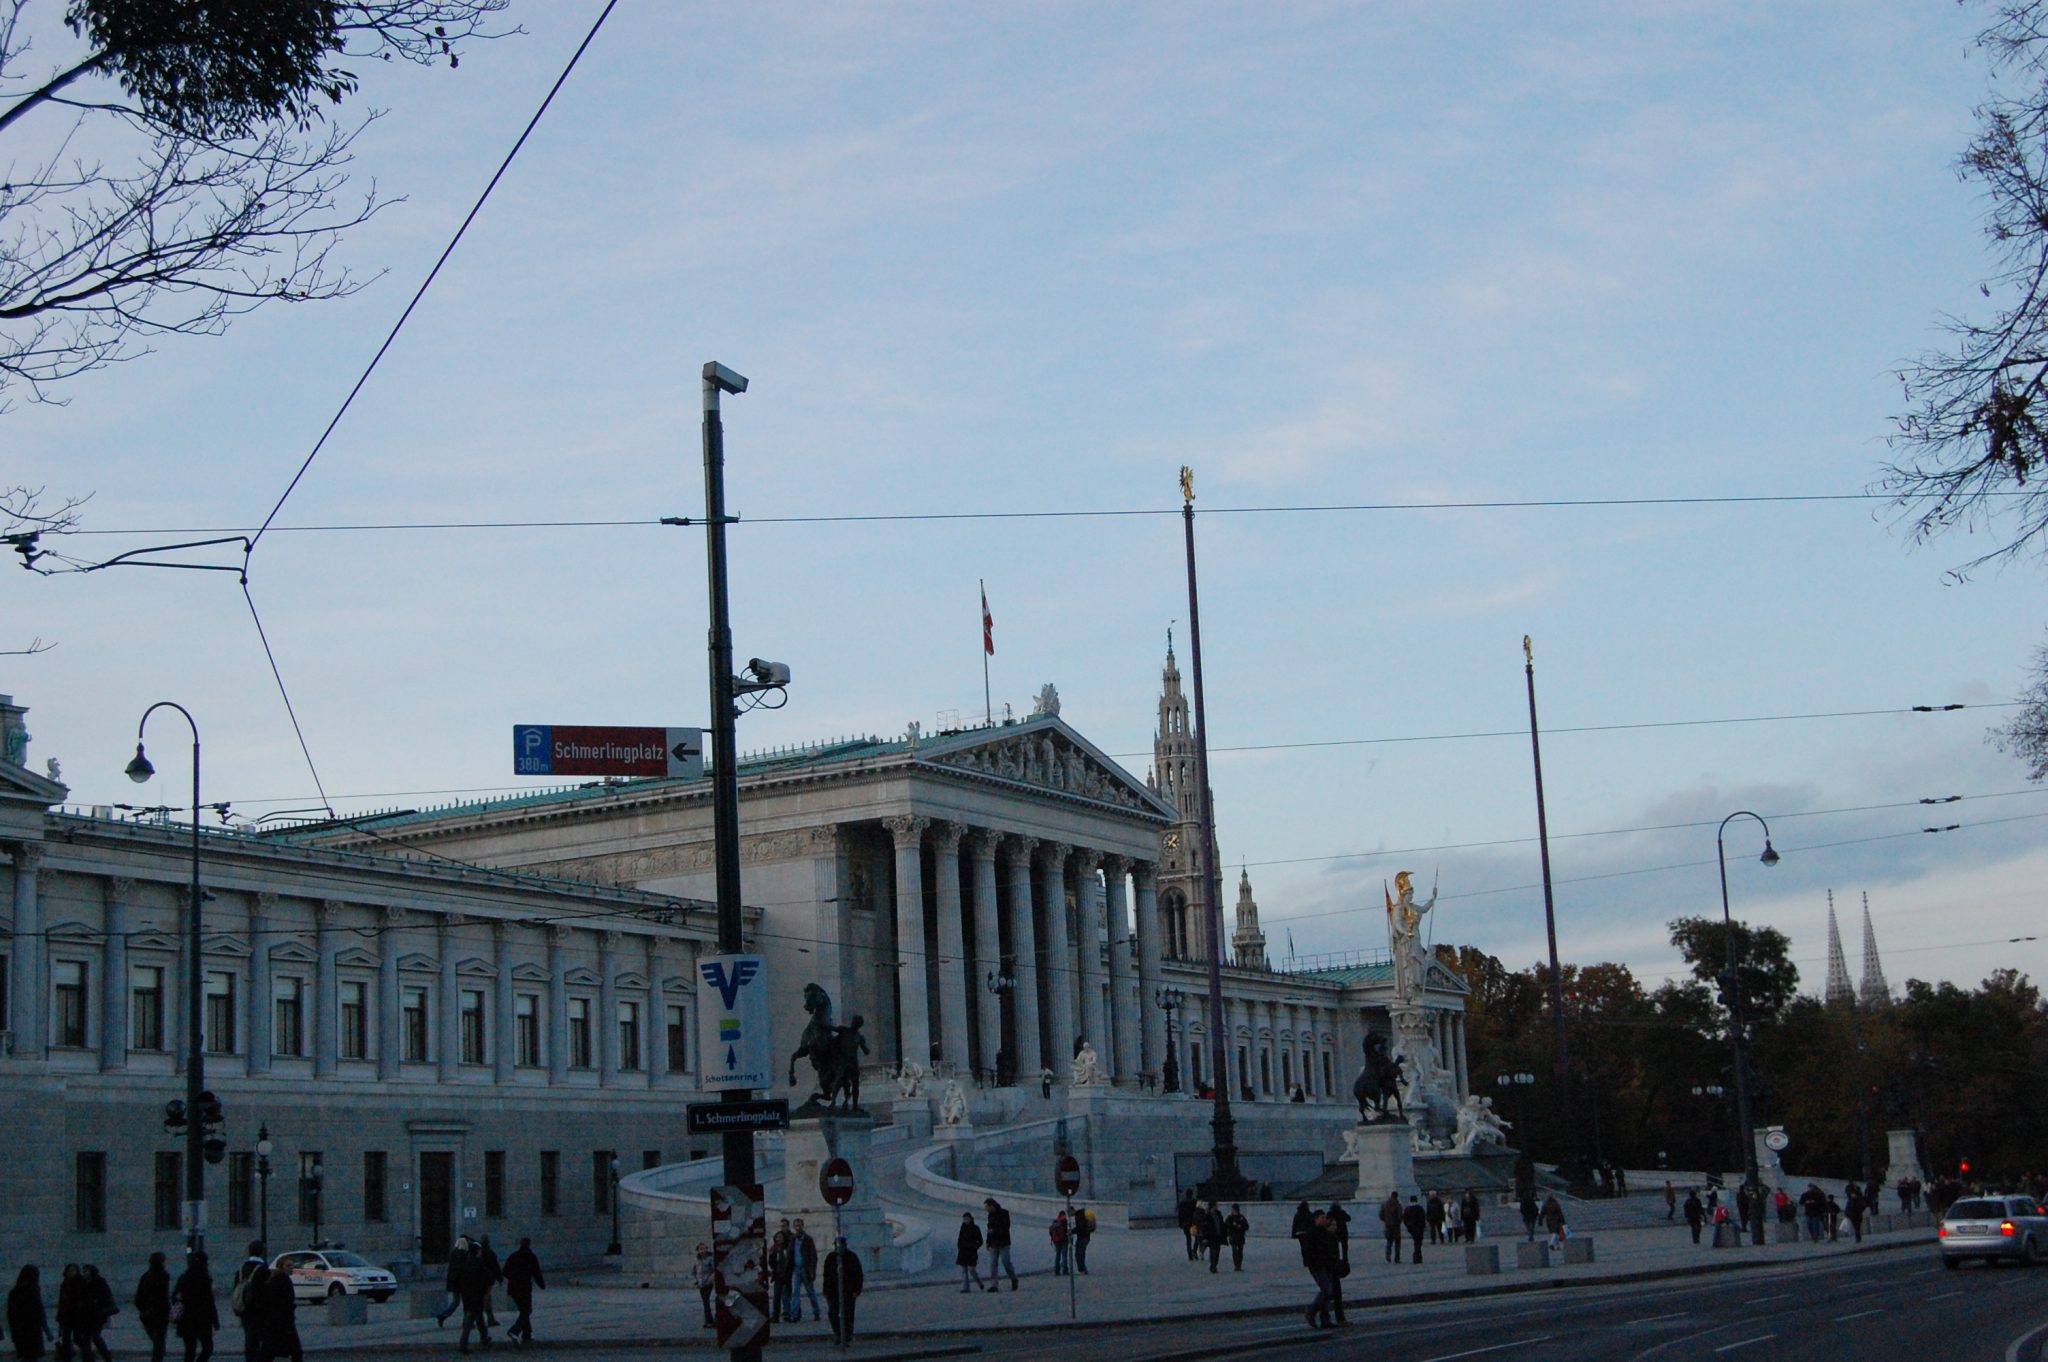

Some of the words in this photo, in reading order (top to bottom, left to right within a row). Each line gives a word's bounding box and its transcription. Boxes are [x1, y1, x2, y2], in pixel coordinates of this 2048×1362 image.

[525, 734, 541, 755] P
[555, 741, 664, 763] Schmerlingplatz
[705, 1074, 757, 1084] Schottenring
[706, 1109, 781, 1125] Schmerlingplatz
